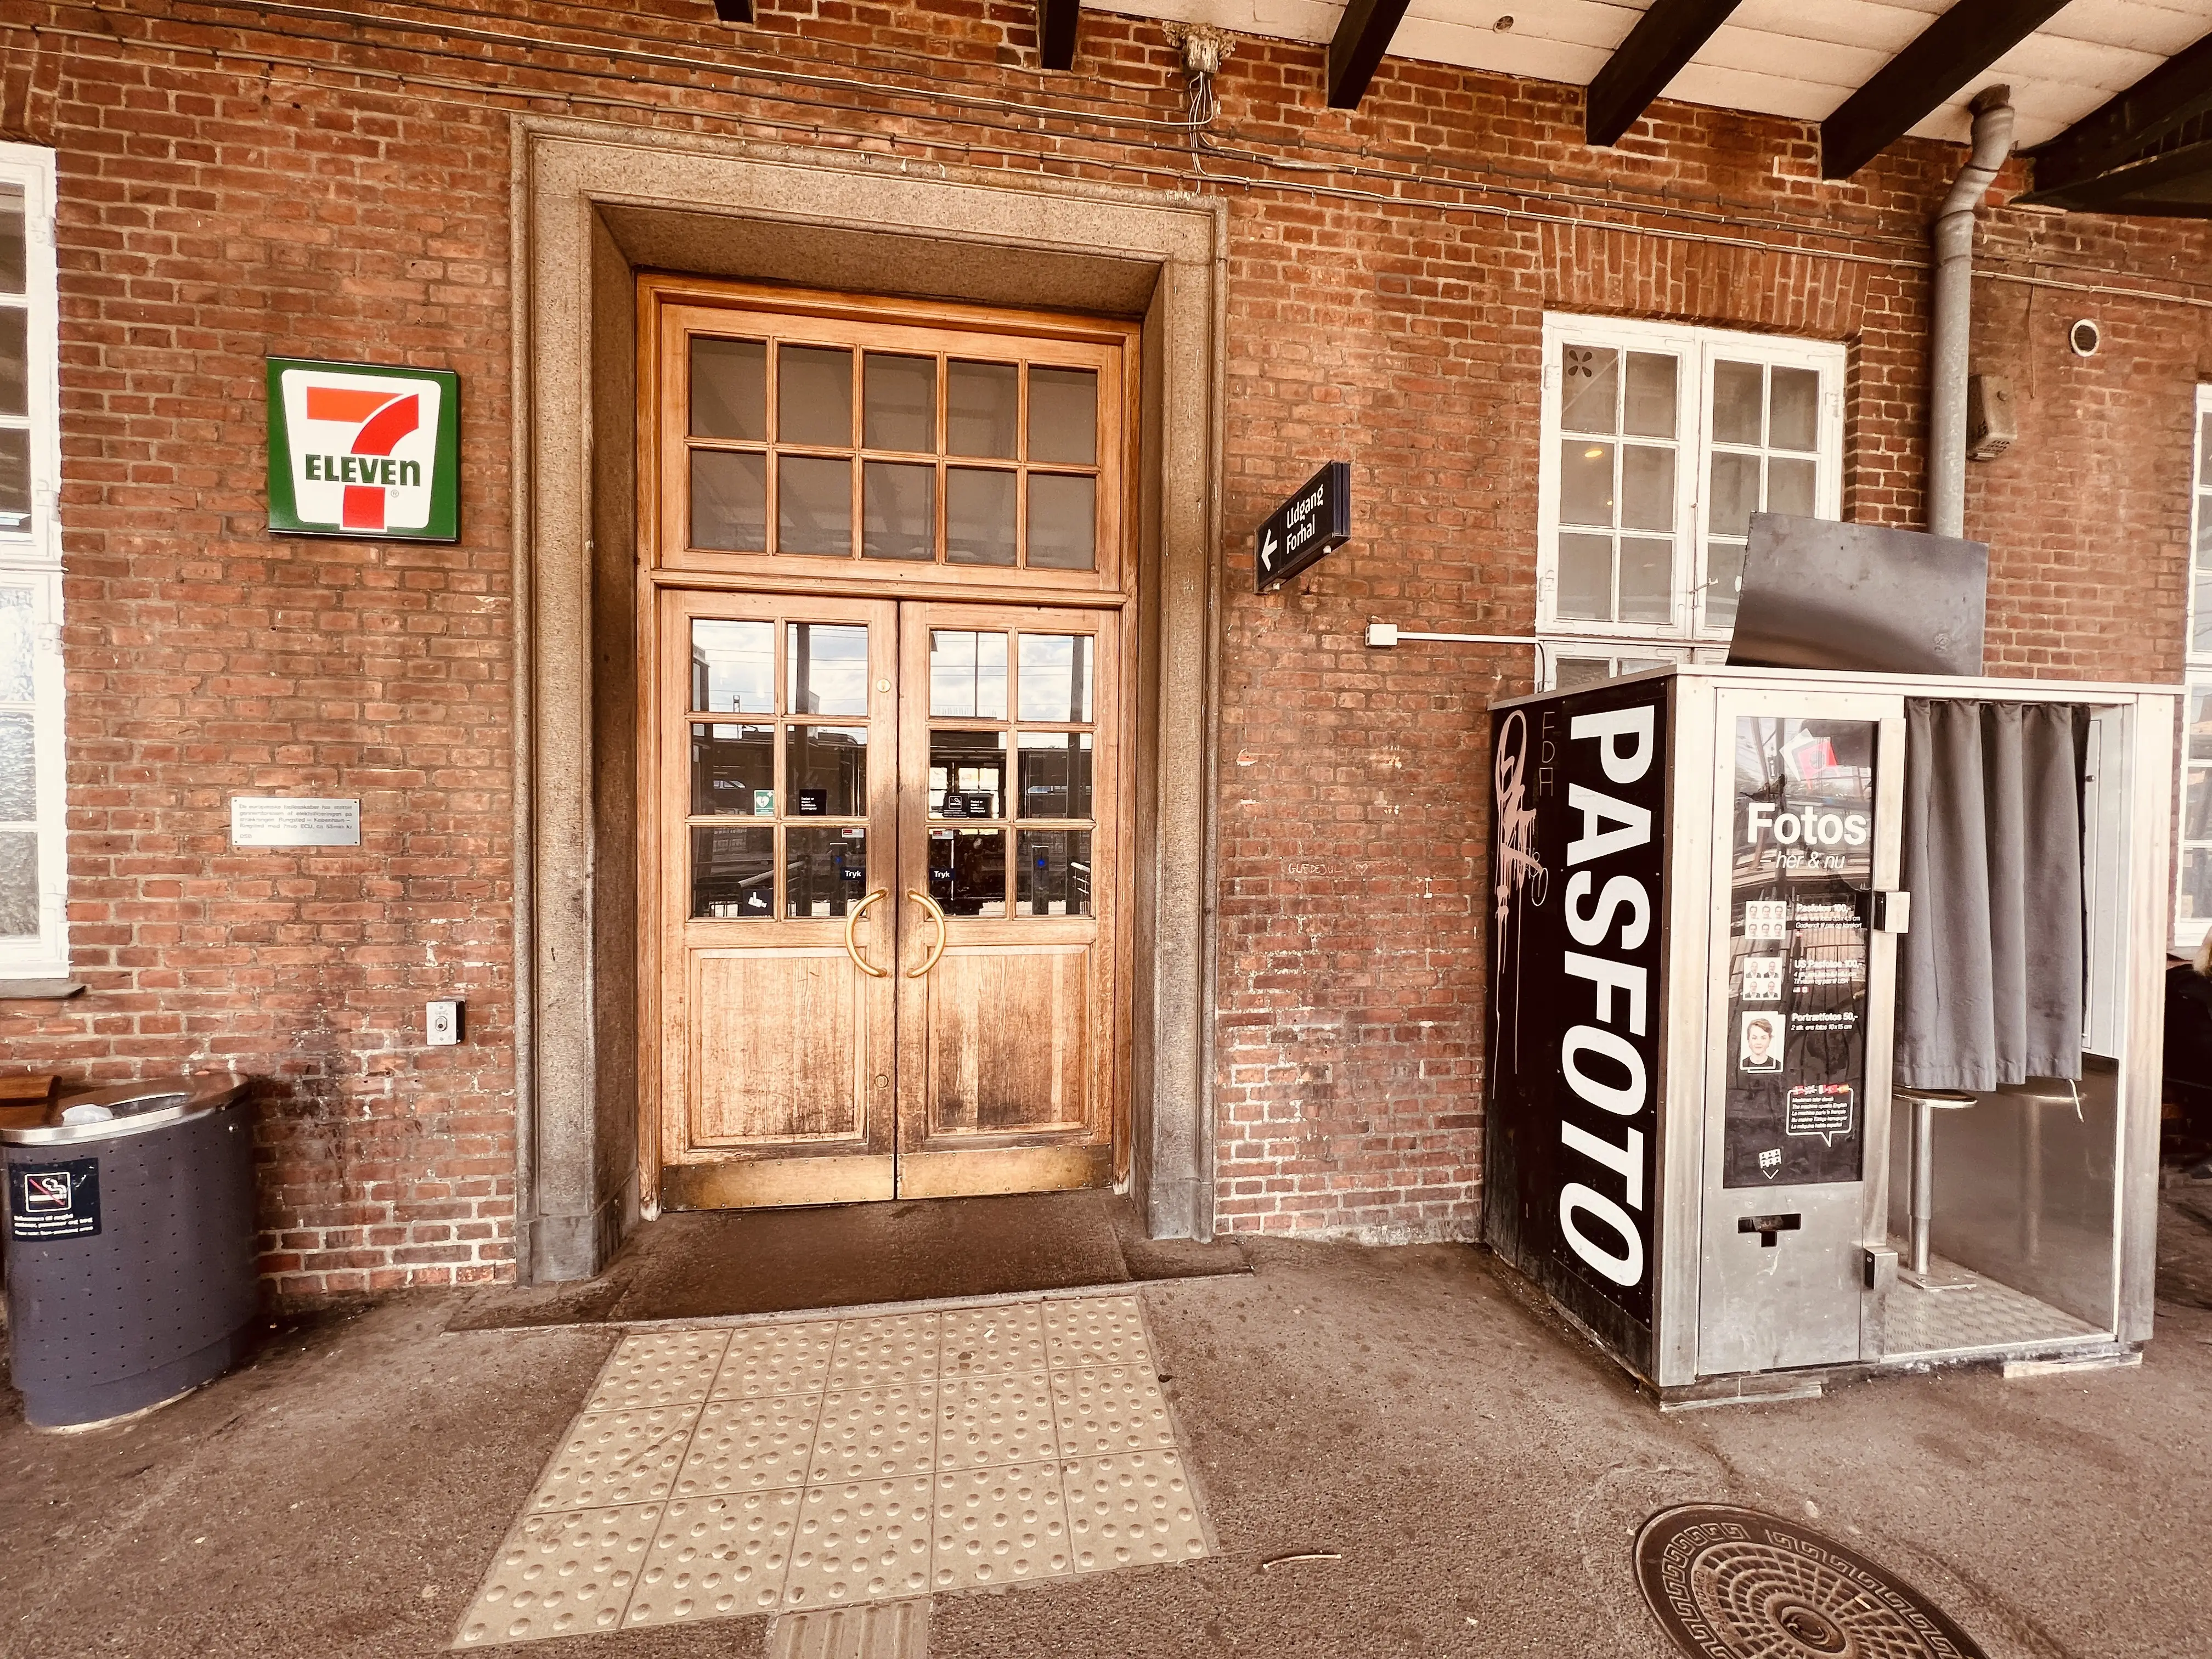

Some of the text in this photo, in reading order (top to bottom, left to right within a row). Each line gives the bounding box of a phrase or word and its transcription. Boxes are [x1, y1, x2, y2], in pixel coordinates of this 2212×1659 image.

[307, 386, 419, 529] 7
[1286, 483, 1324, 528] Udgang
[1286, 514, 1316, 554] Forhal
[1747, 802, 1867, 845] Fotos
[1775, 851, 1804, 868] her
[1807, 851, 1820, 868] &
[1824, 855, 1846, 868] nu
[844, 870, 861, 878] Tryk
[934, 871, 950, 879] Tryk
[1796, 902, 1831, 912] Pasfotos
[1794, 960, 1807, 969] US
[1807, 959, 1842, 969] Pasfotos
[1559, 705, 1655, 1287] PASFOTO
[1791, 1012, 1842, 1022] Portrætfotos
